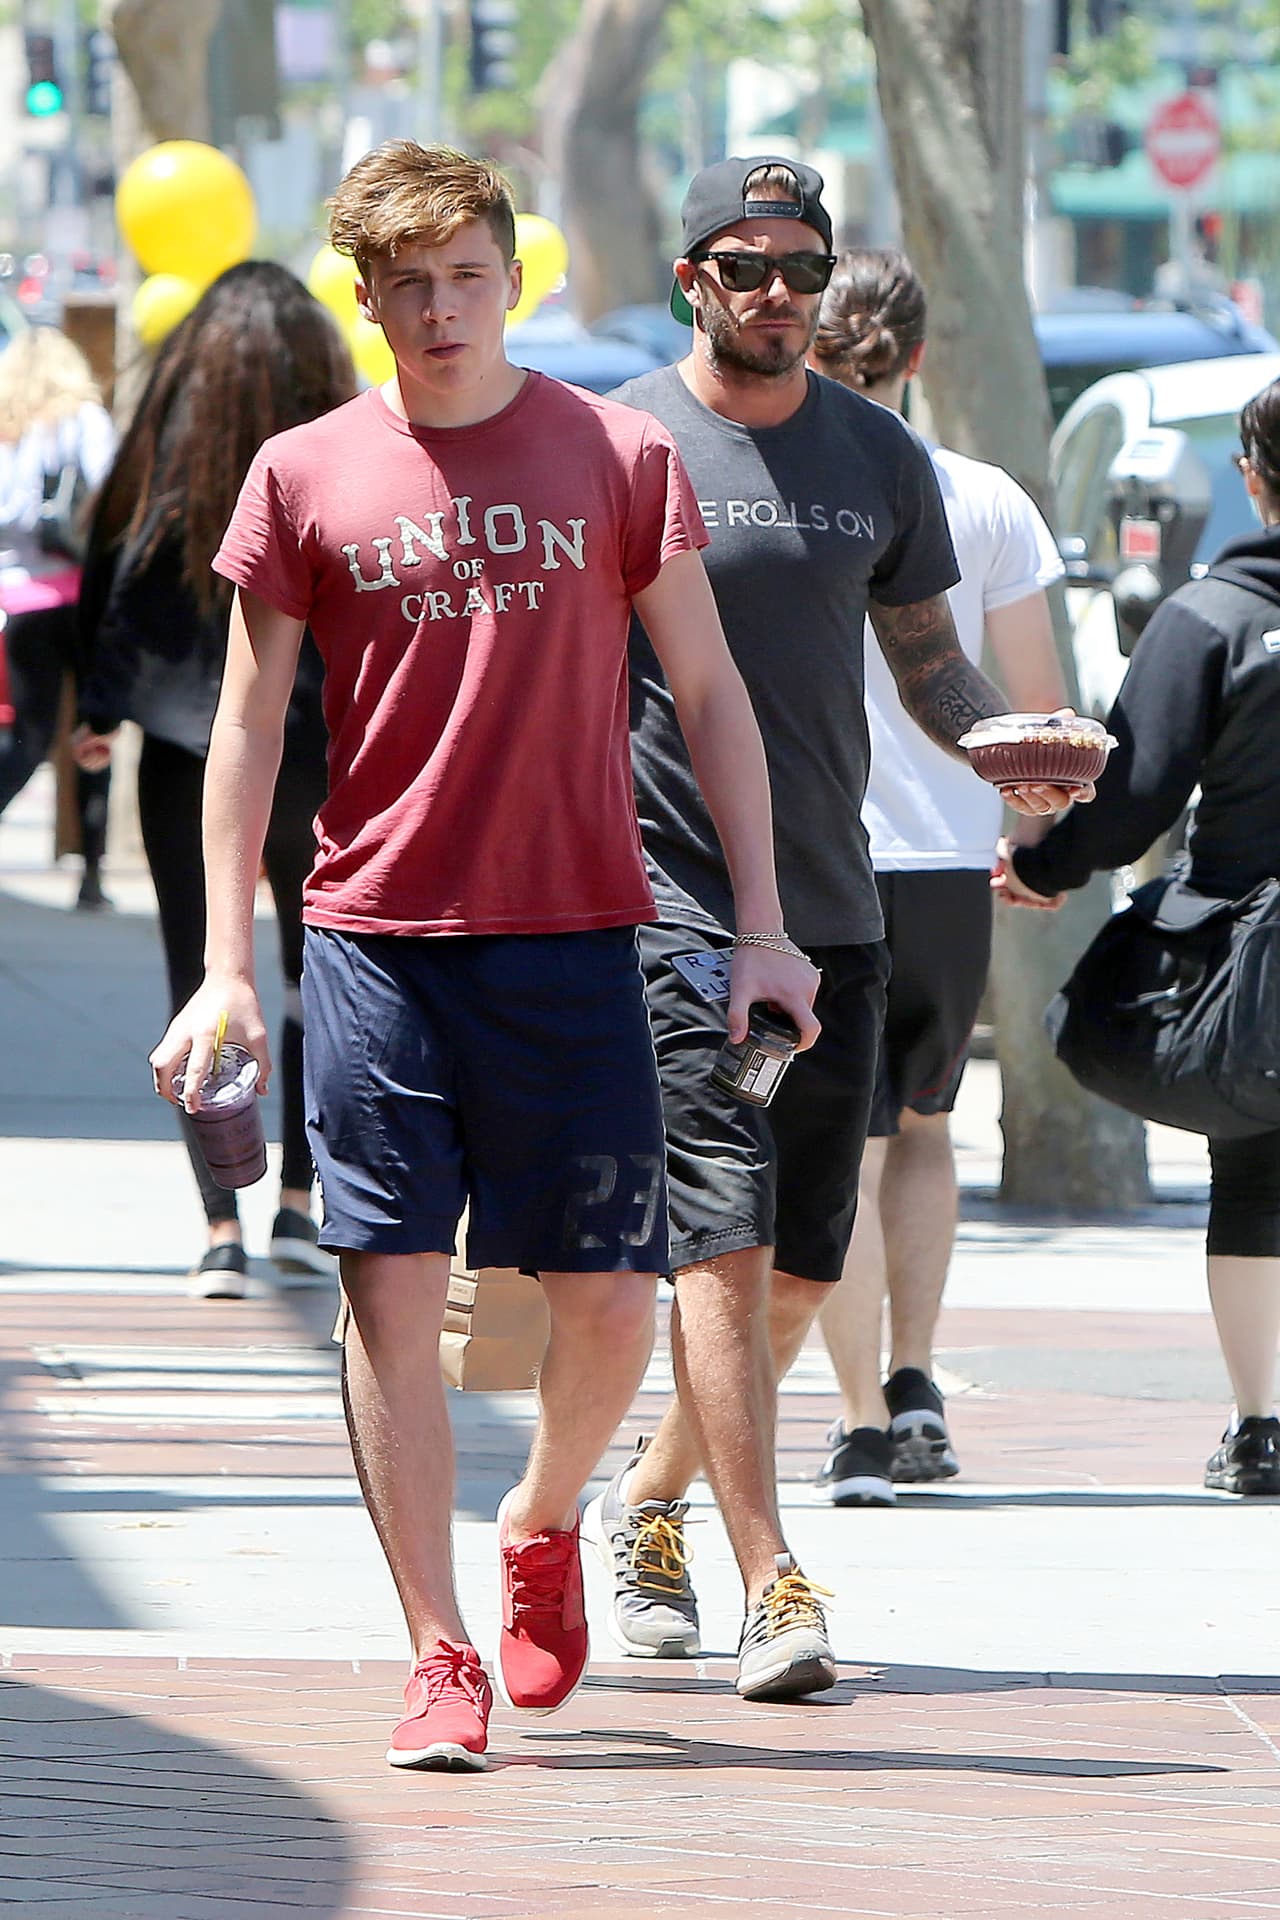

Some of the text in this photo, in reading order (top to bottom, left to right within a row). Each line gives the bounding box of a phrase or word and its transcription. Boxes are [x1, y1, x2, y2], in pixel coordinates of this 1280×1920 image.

[727, 499, 830, 532] ROLLS
[341, 496, 587, 592] UNION
[453, 558, 485, 580] OF
[401, 580, 545, 623] CRAFT
[563, 1153, 661, 1249] 23
